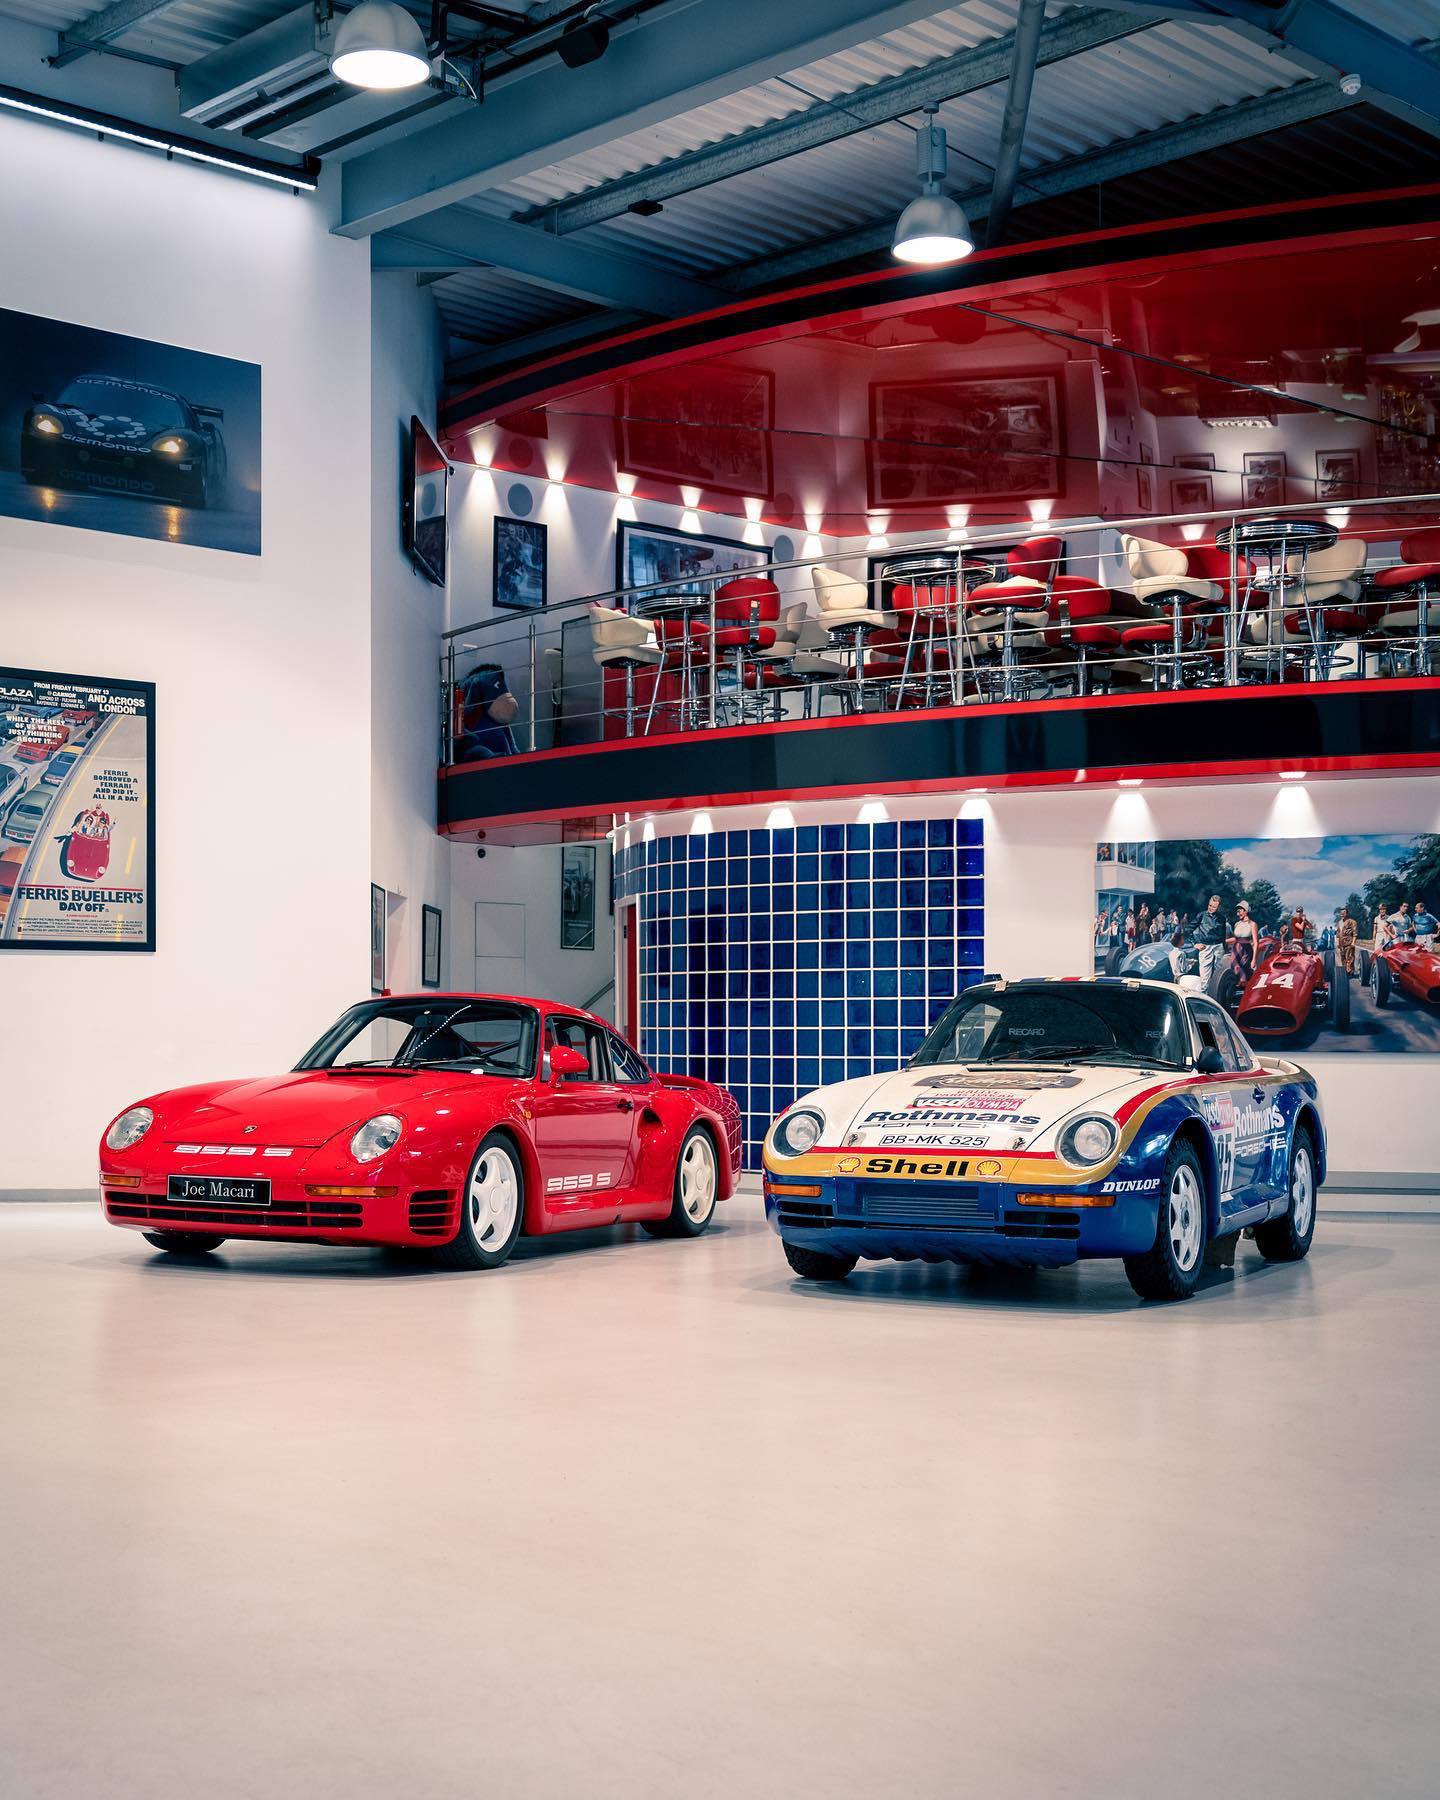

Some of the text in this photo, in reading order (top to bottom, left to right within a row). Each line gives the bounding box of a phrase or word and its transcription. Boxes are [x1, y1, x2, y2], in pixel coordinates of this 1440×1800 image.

[72, 686, 102, 694] FEBRUARY
[88, 694, 145, 707] AND ACROSS
[99, 704, 136, 714] LONDON
[28, 730, 62, 738] THINKING
[18, 887, 144, 904] FERRIS BUELLER'S
[59, 902, 84, 912] DAY
[84, 903, 105, 912] OFF
[1138, 956, 1156, 968] 18
[1252, 973, 1294, 990] 14
[964, 1100, 1021, 1111] OLYMPIA
[864, 1110, 1041, 1125] Rothmans
[1234, 1103, 1285, 1138] Rothmans
[882, 1135, 986, 1146] BB-MK 525
[1235, 1136, 1288, 1157] PORSCHE
[173, 1144, 294, 1157] 959 S
[866, 1158, 970, 1176] Shell
[182, 1180, 255, 1198] Joe Macari
[546, 1172, 612, 1192] 959 S
[1100, 1178, 1161, 1193] DUNLOP
